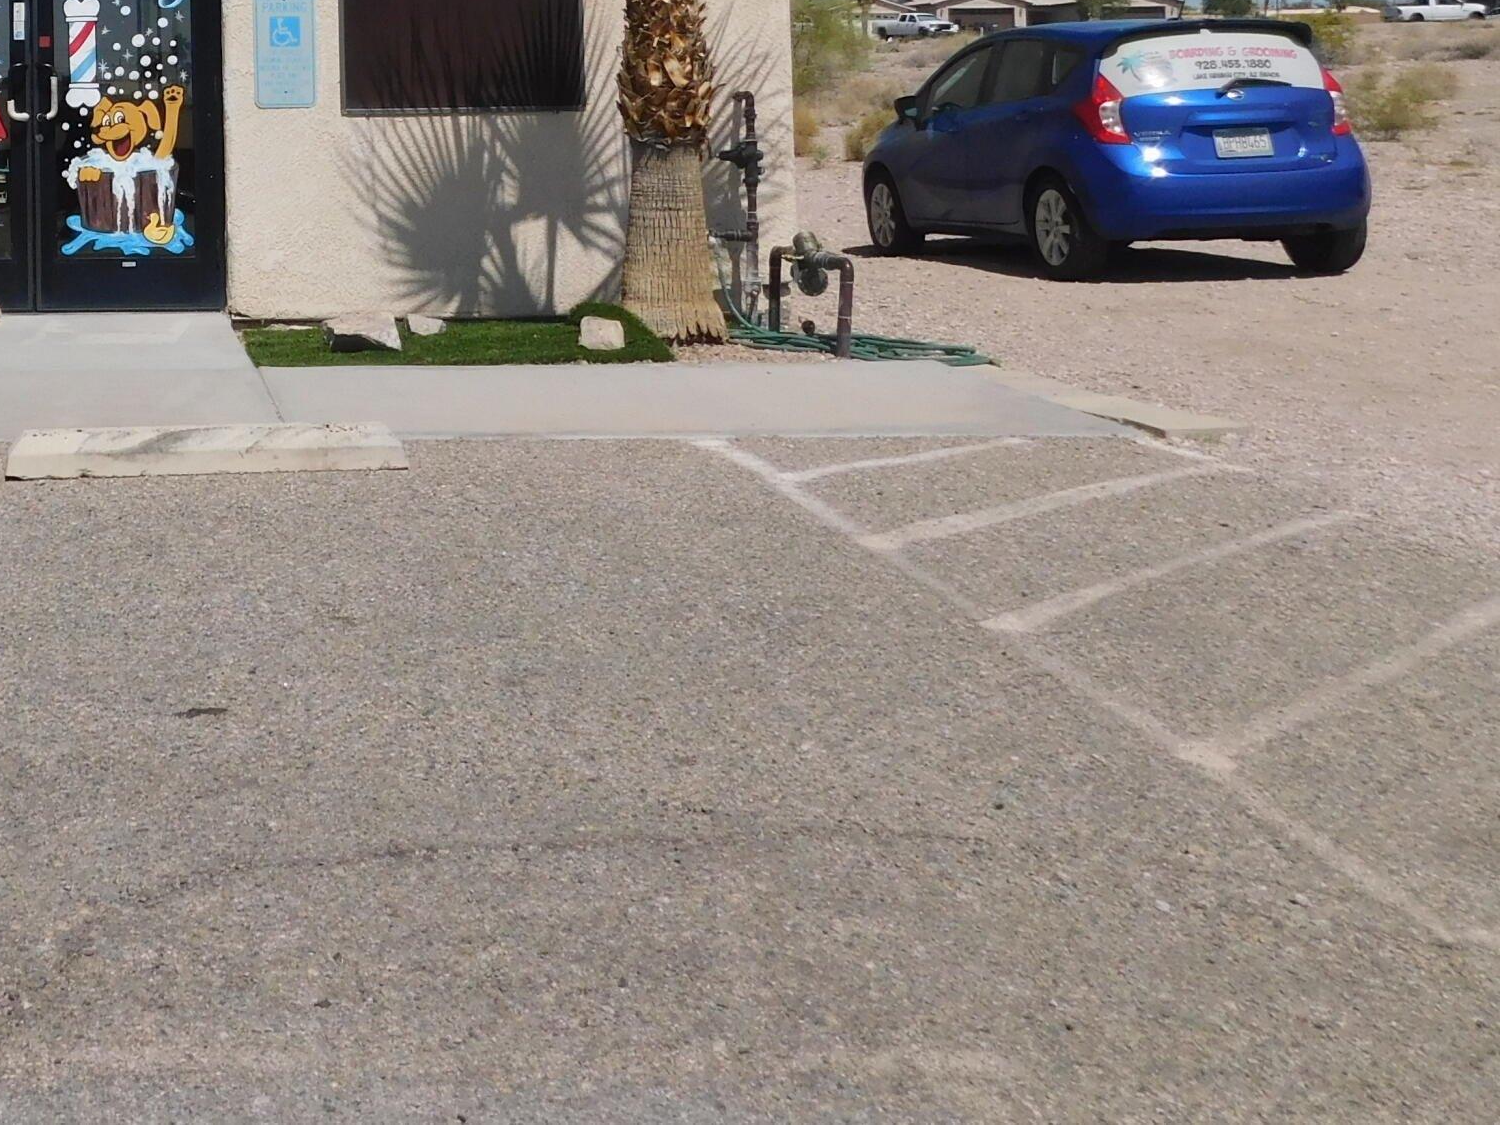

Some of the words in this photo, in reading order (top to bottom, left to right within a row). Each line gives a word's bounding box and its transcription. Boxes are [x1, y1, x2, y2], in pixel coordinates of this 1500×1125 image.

[262, 1, 308, 12] PARKING
[1169, 47, 1224, 59] BOARDING
[1242, 47, 1298, 59] GROOMING
